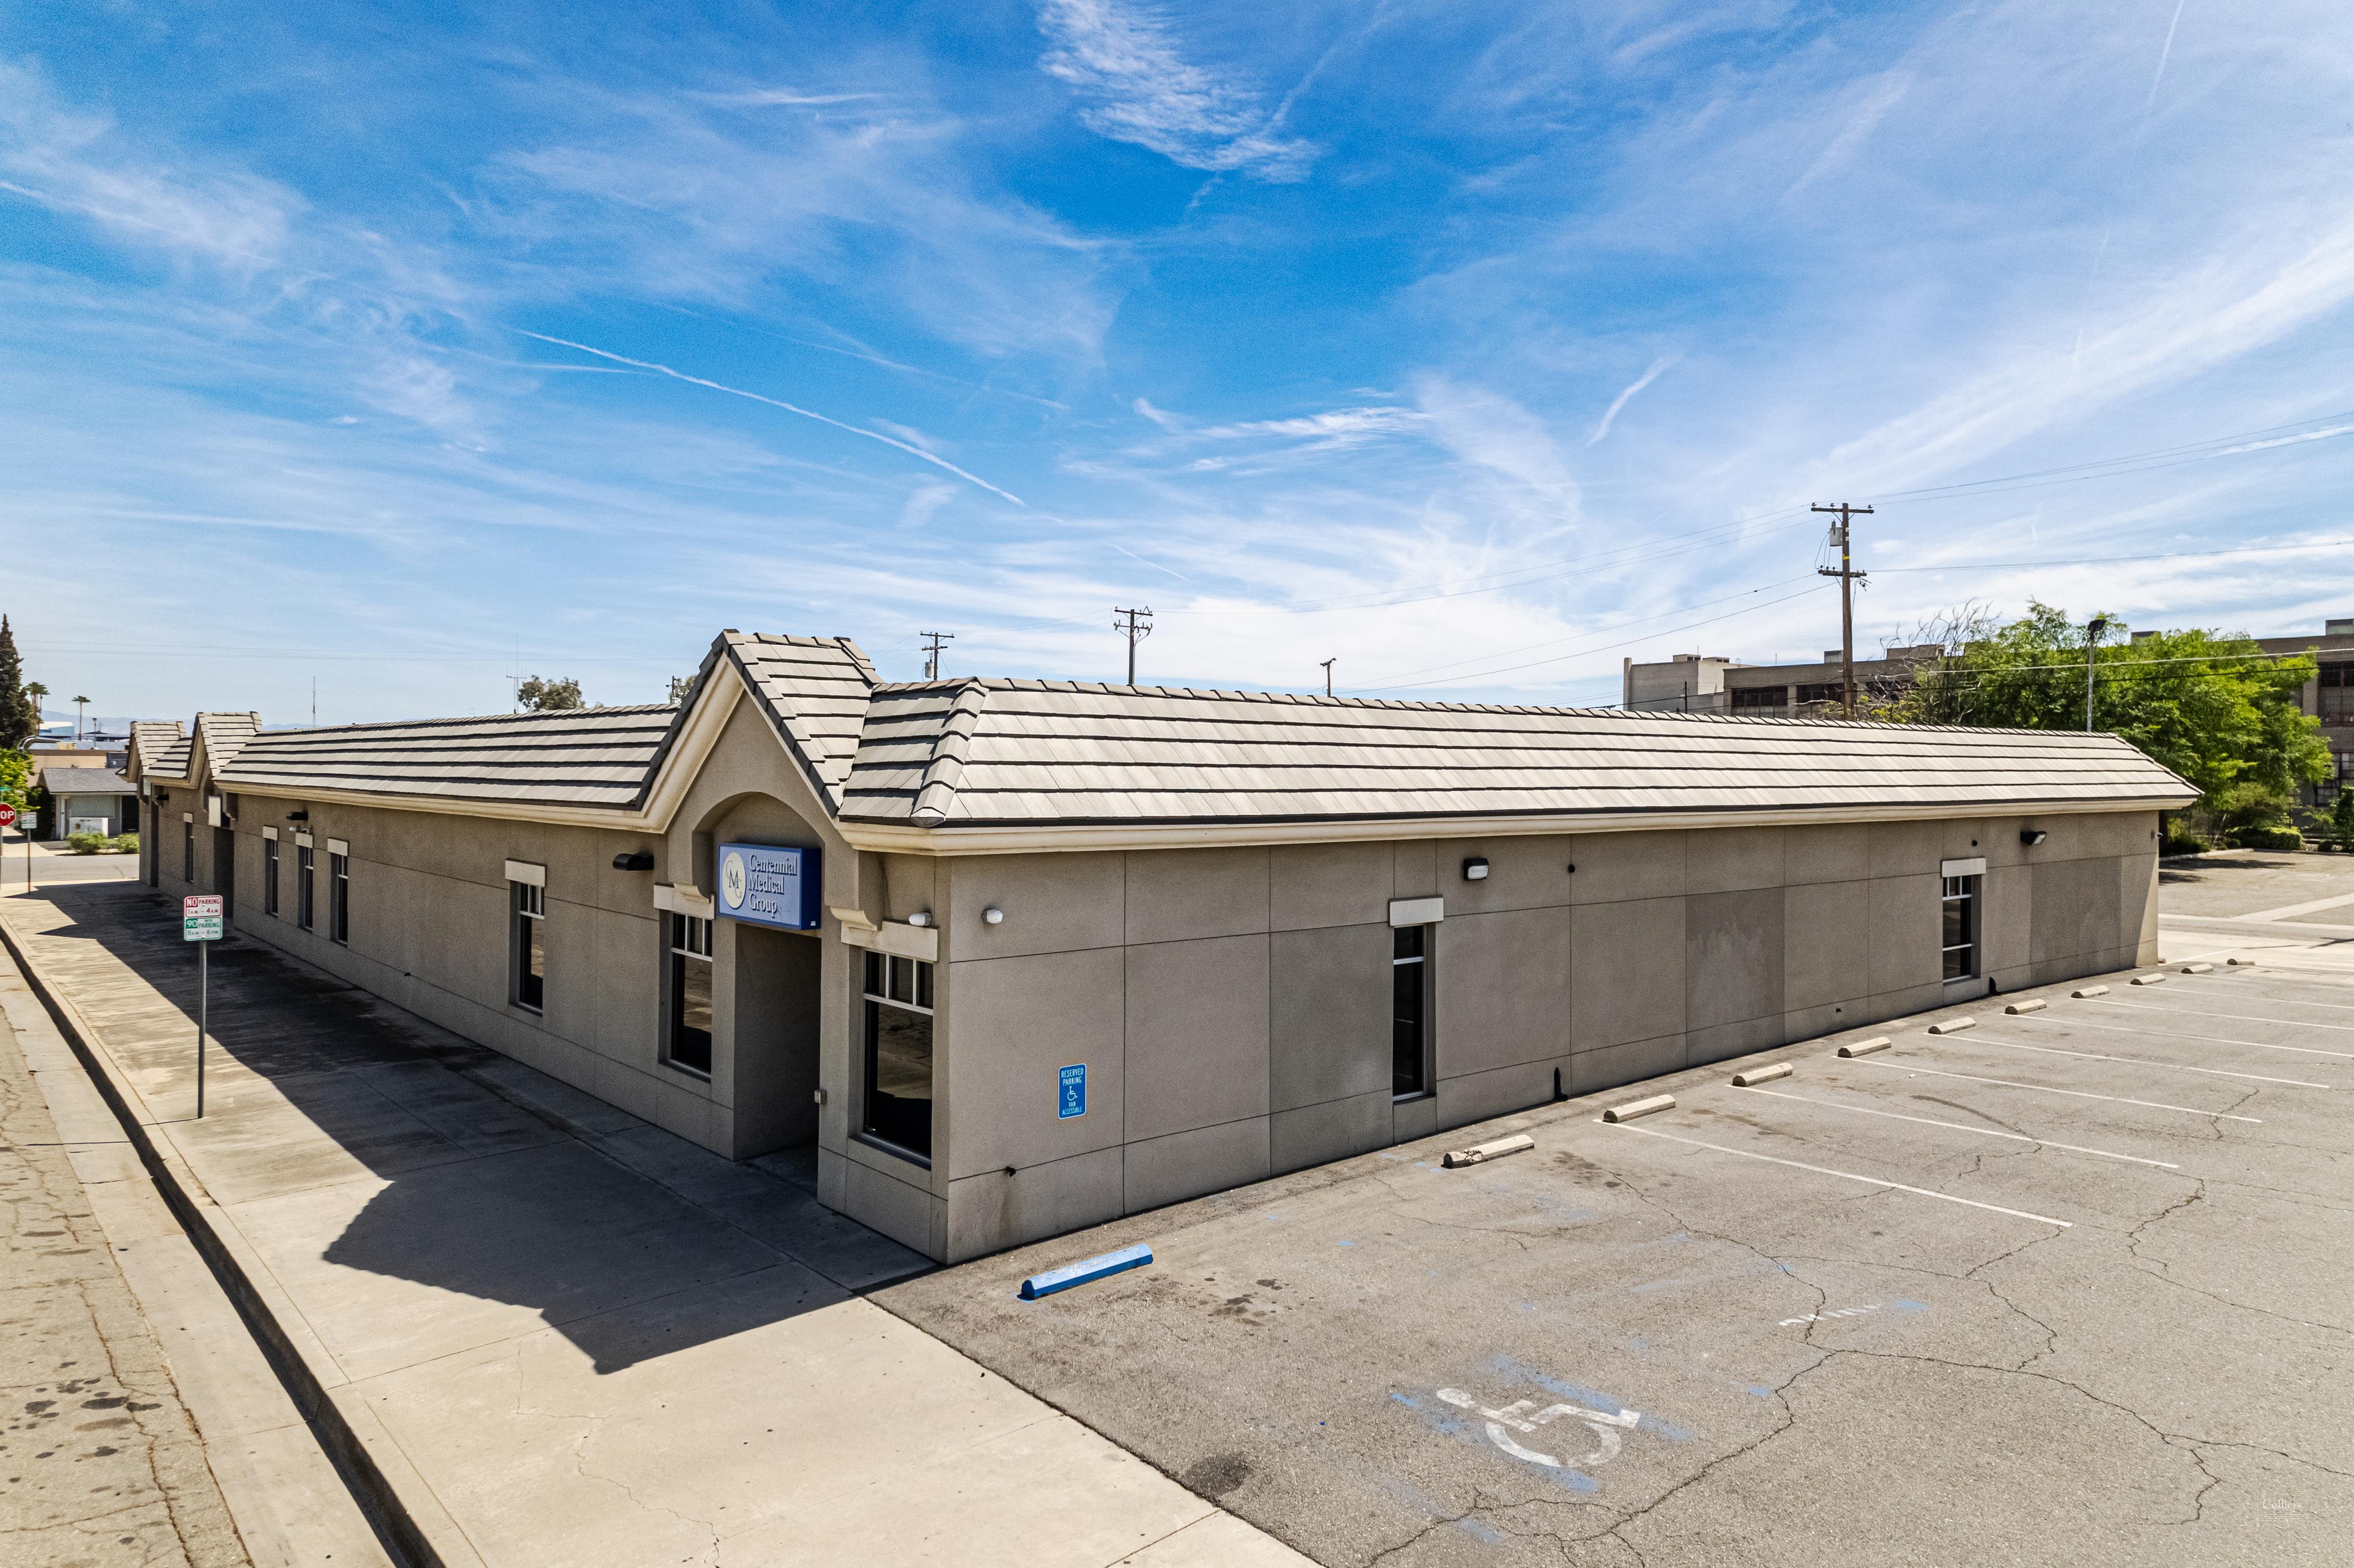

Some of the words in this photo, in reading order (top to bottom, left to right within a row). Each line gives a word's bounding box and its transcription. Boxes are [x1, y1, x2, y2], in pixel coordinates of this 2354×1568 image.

[0, 811, 14, 819] OP
[749, 854, 798, 876] Centennial
[749, 873, 785, 895] Medical
[187, 898, 197, 907] NO
[749, 893, 778, 918] Group
[1061, 1068, 1084, 1078] RESERVED
[1063, 1076, 1082, 1086] PARKING
[1062, 1106, 1082, 1115] ACCESSIBLE
